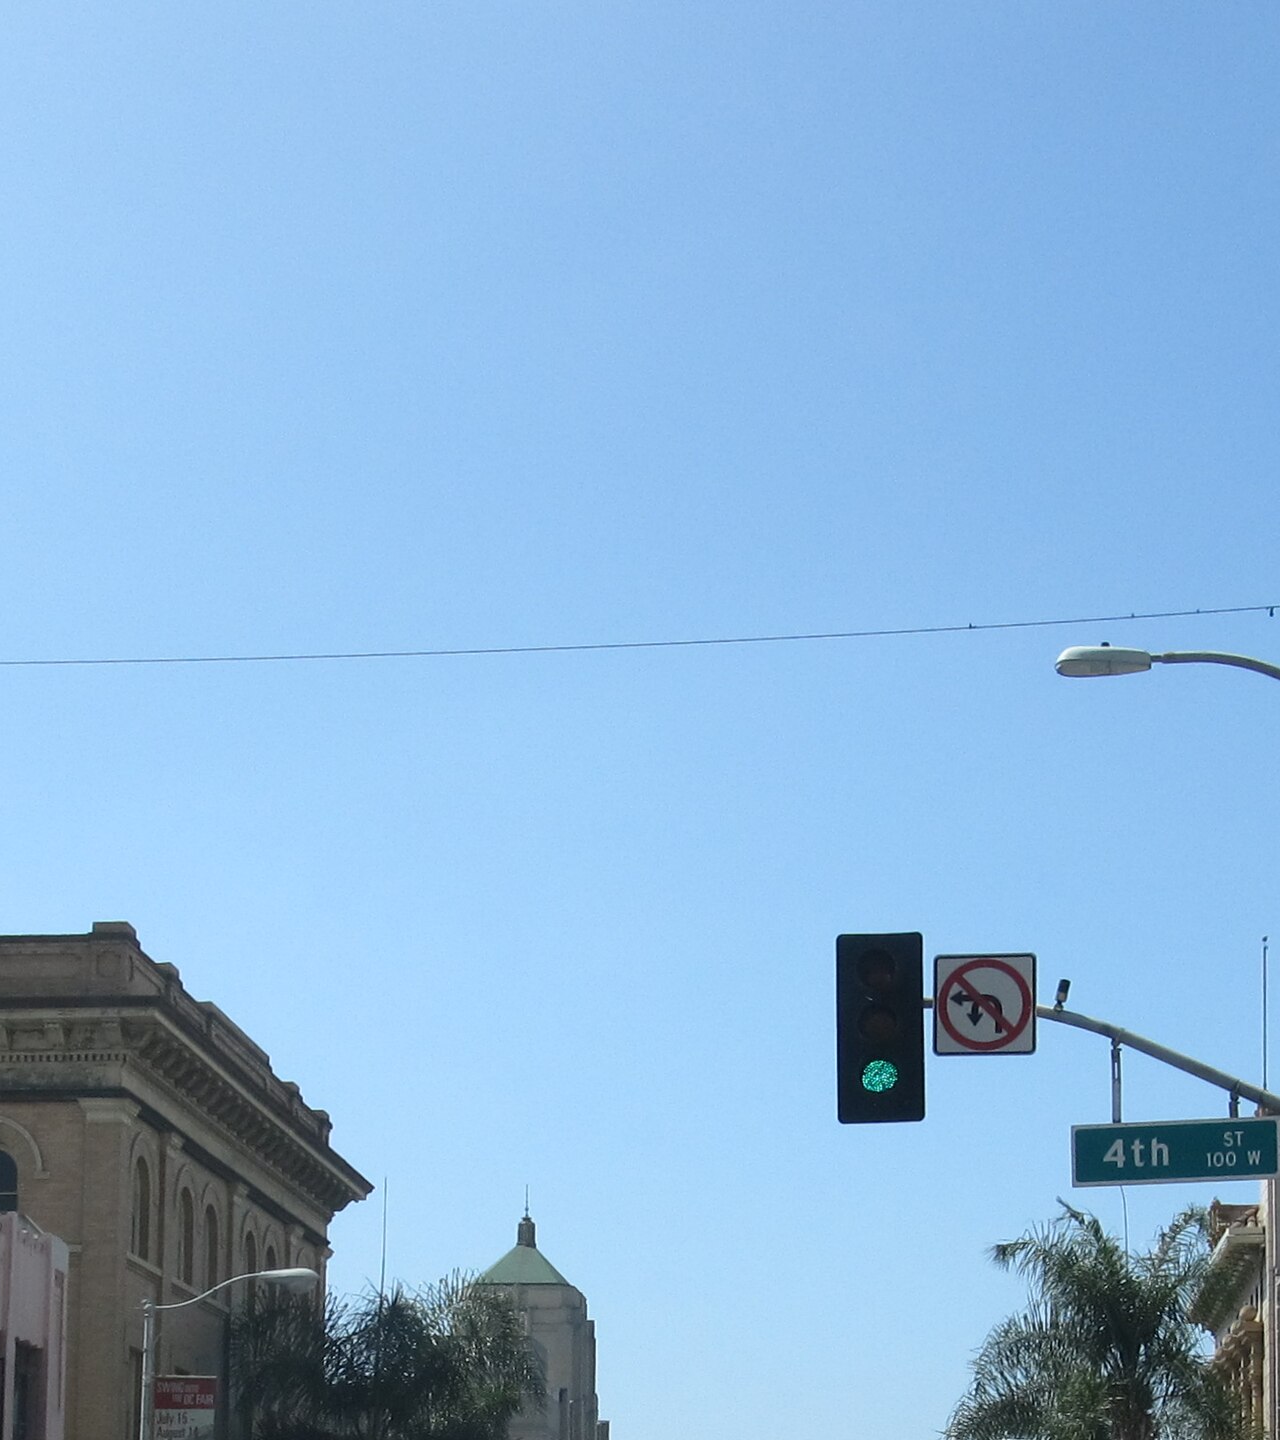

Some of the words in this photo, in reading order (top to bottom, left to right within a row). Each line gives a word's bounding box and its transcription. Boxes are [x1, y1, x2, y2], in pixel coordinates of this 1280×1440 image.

[1102, 1136, 1170, 1169] 4th
[1223, 1130, 1245, 1147] ST
[1206, 1151, 1237, 1168] 100
[1247, 1150, 1262, 1166] W
[157, 1412, 175, 1425] July
[156, 1426, 186, 1440] August
